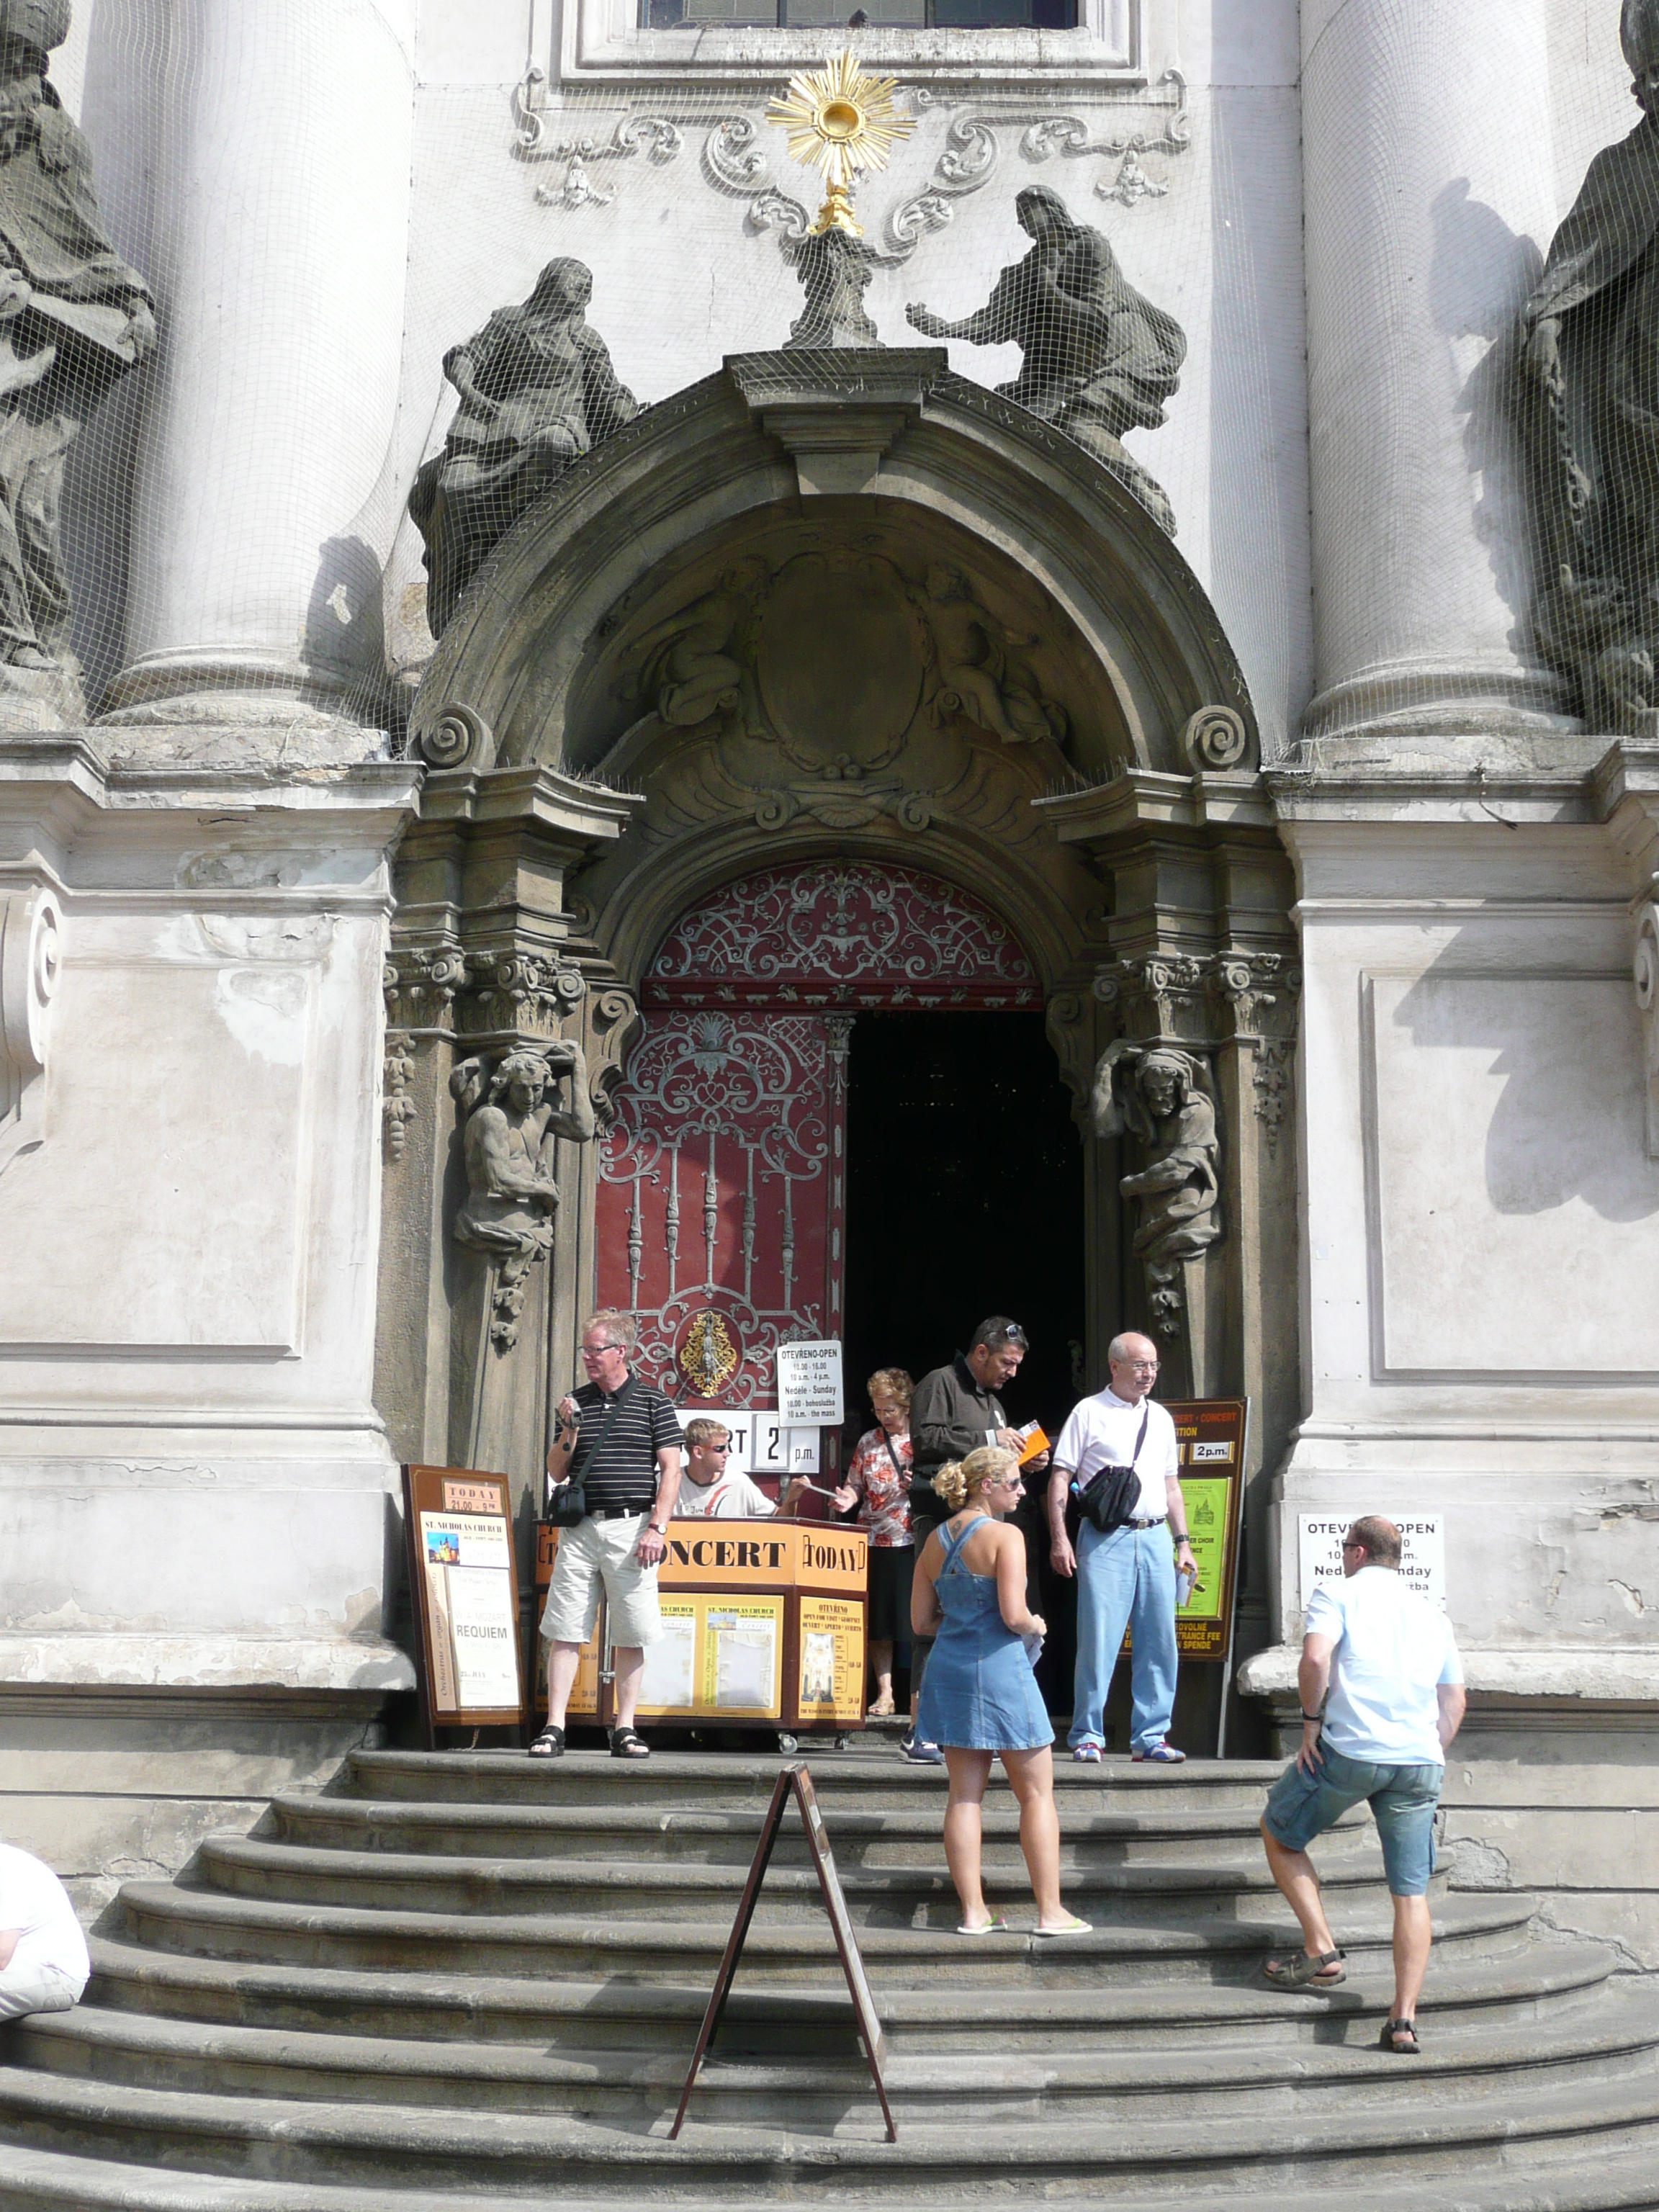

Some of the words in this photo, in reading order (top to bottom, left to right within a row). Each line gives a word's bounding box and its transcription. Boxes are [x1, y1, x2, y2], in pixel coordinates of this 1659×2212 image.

[813, 1384, 837, 1395] Sunday
[788, 1409, 794, 1418] 10
[1200, 1411, 1237, 1423] CONCERT
[1174, 1426, 1198, 1437] ITION
[768, 1426, 779, 1460] 2
[795, 1447, 814, 1462] p.m.
[449, 1488, 495, 1499] TODAY
[438, 1521, 472, 1532] NICHOLAS
[474, 1523, 502, 1533] CHURCH
[804, 1544, 859, 1572] TODAY
[1315, 1565, 1343, 1575] Ned
[1398, 1565, 1431, 1578] nday
[475, 1611, 506, 1622] MOZART
[457, 1624, 508, 1639] REQUIEM
[1176, 1631, 1205, 1640] TRANCE
[1207, 1631, 1221, 1640] FEE
[1183, 1640, 1212, 1650] SPENDE
[438, 1650, 448, 1696] Orchestras
